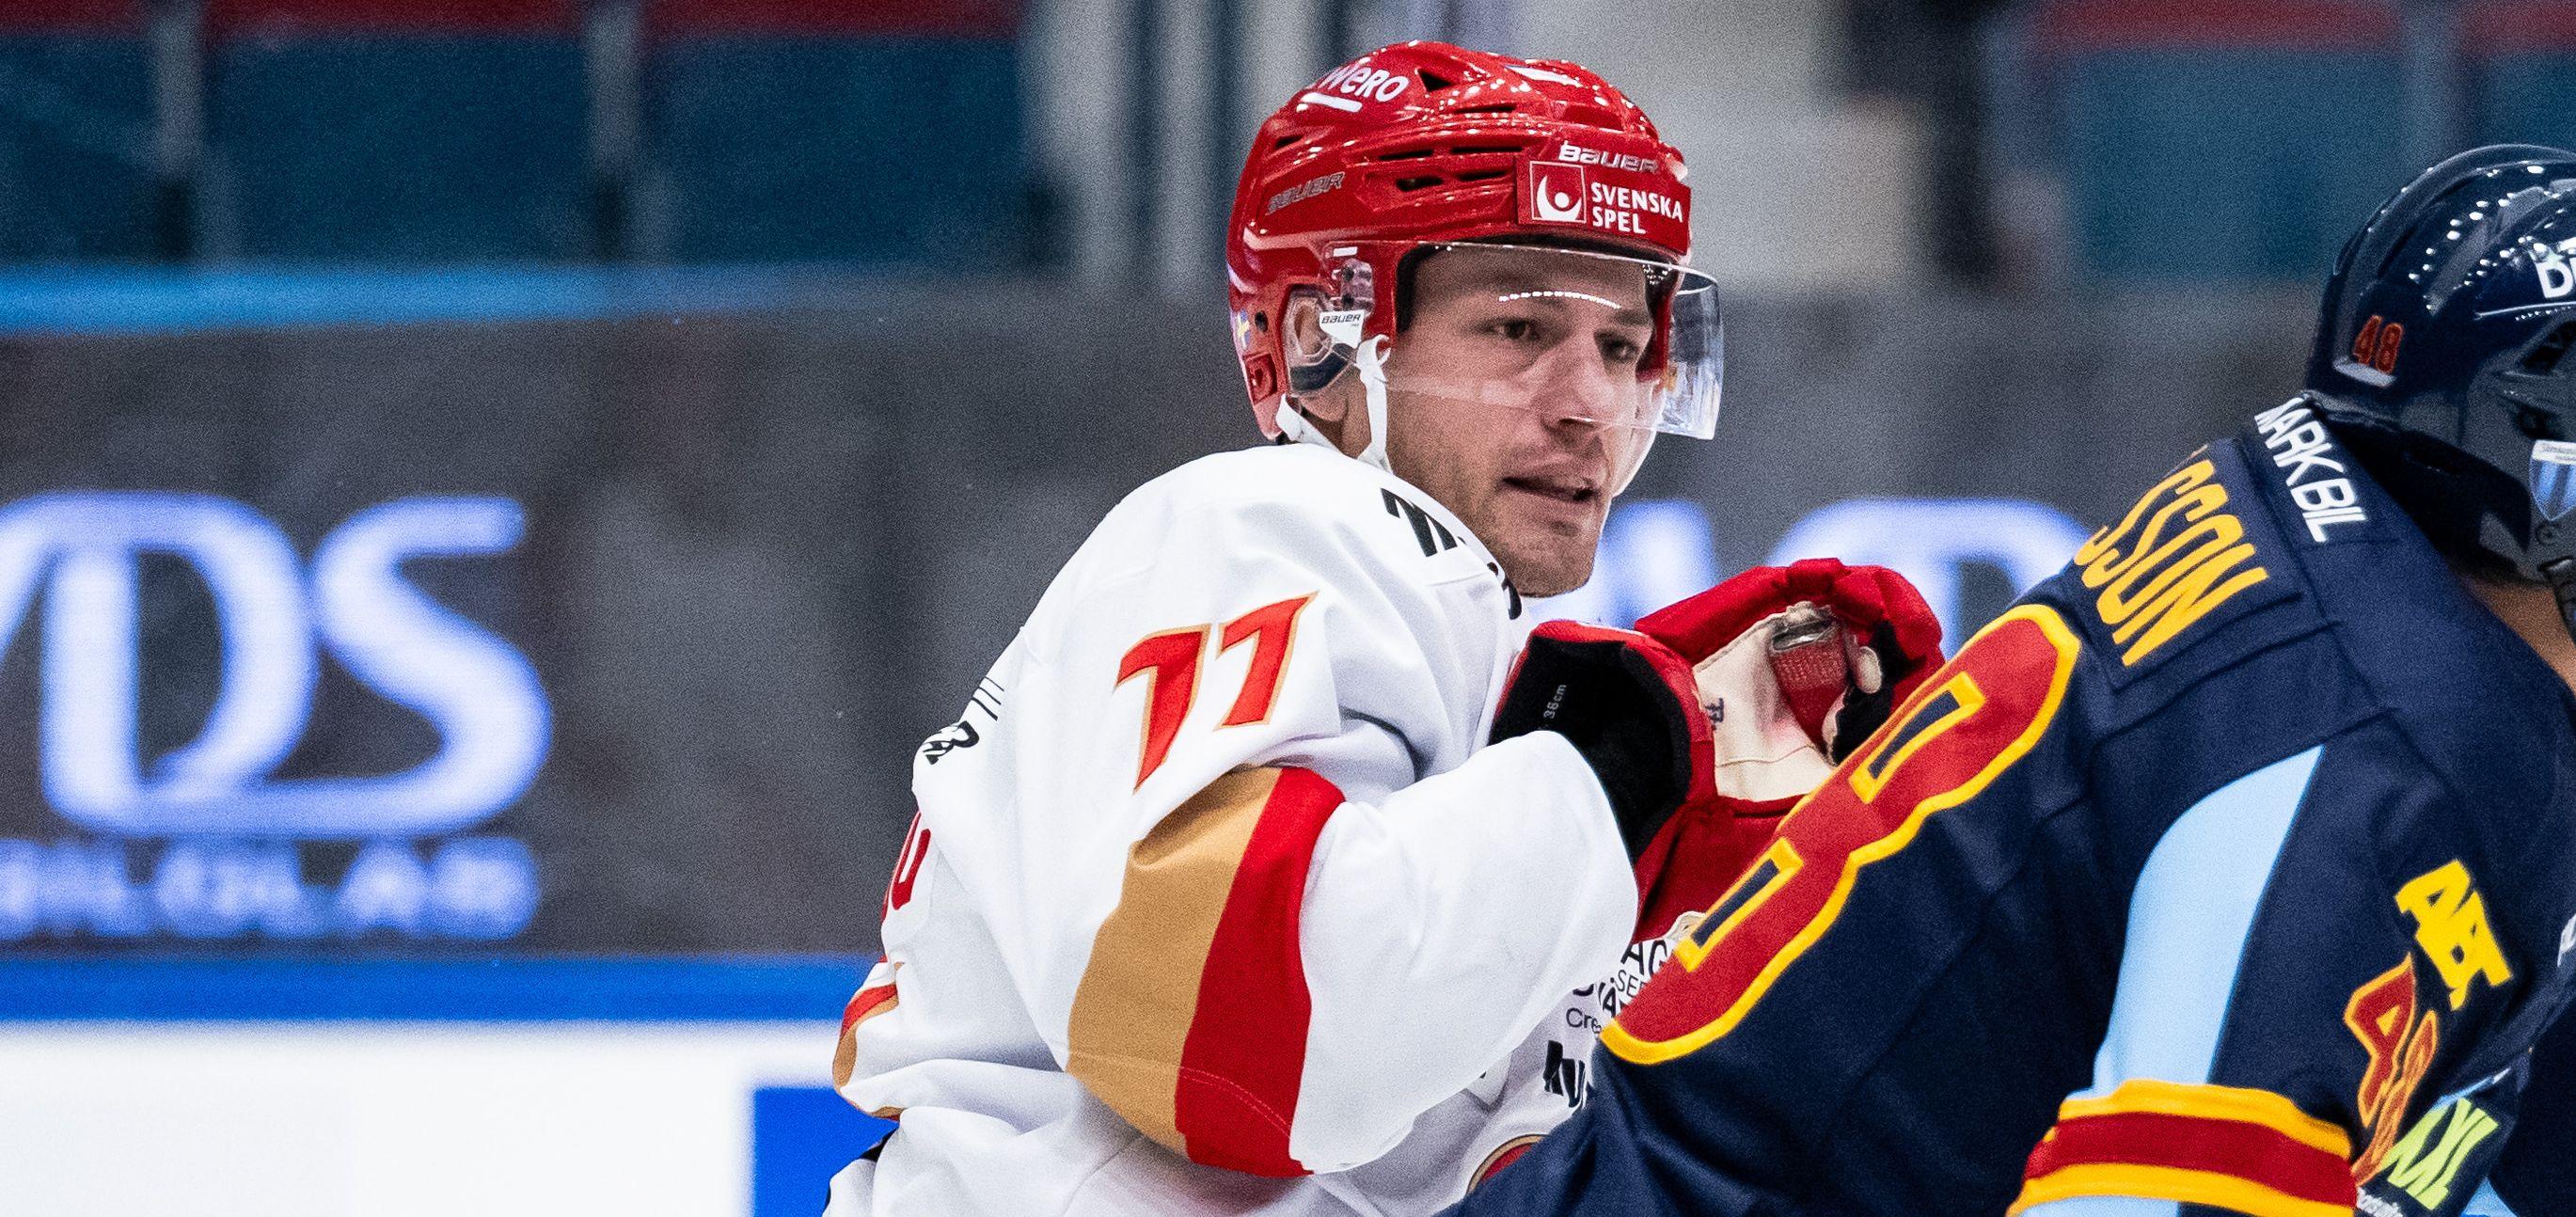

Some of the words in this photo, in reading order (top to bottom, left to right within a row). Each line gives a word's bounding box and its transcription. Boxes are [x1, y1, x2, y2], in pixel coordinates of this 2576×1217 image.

[1590, 182, 1683, 223] SVENSKA
[1592, 206, 1646, 234] SPEL
[2353, 315, 2403, 374] 48
[1114, 591, 1320, 795] 77
